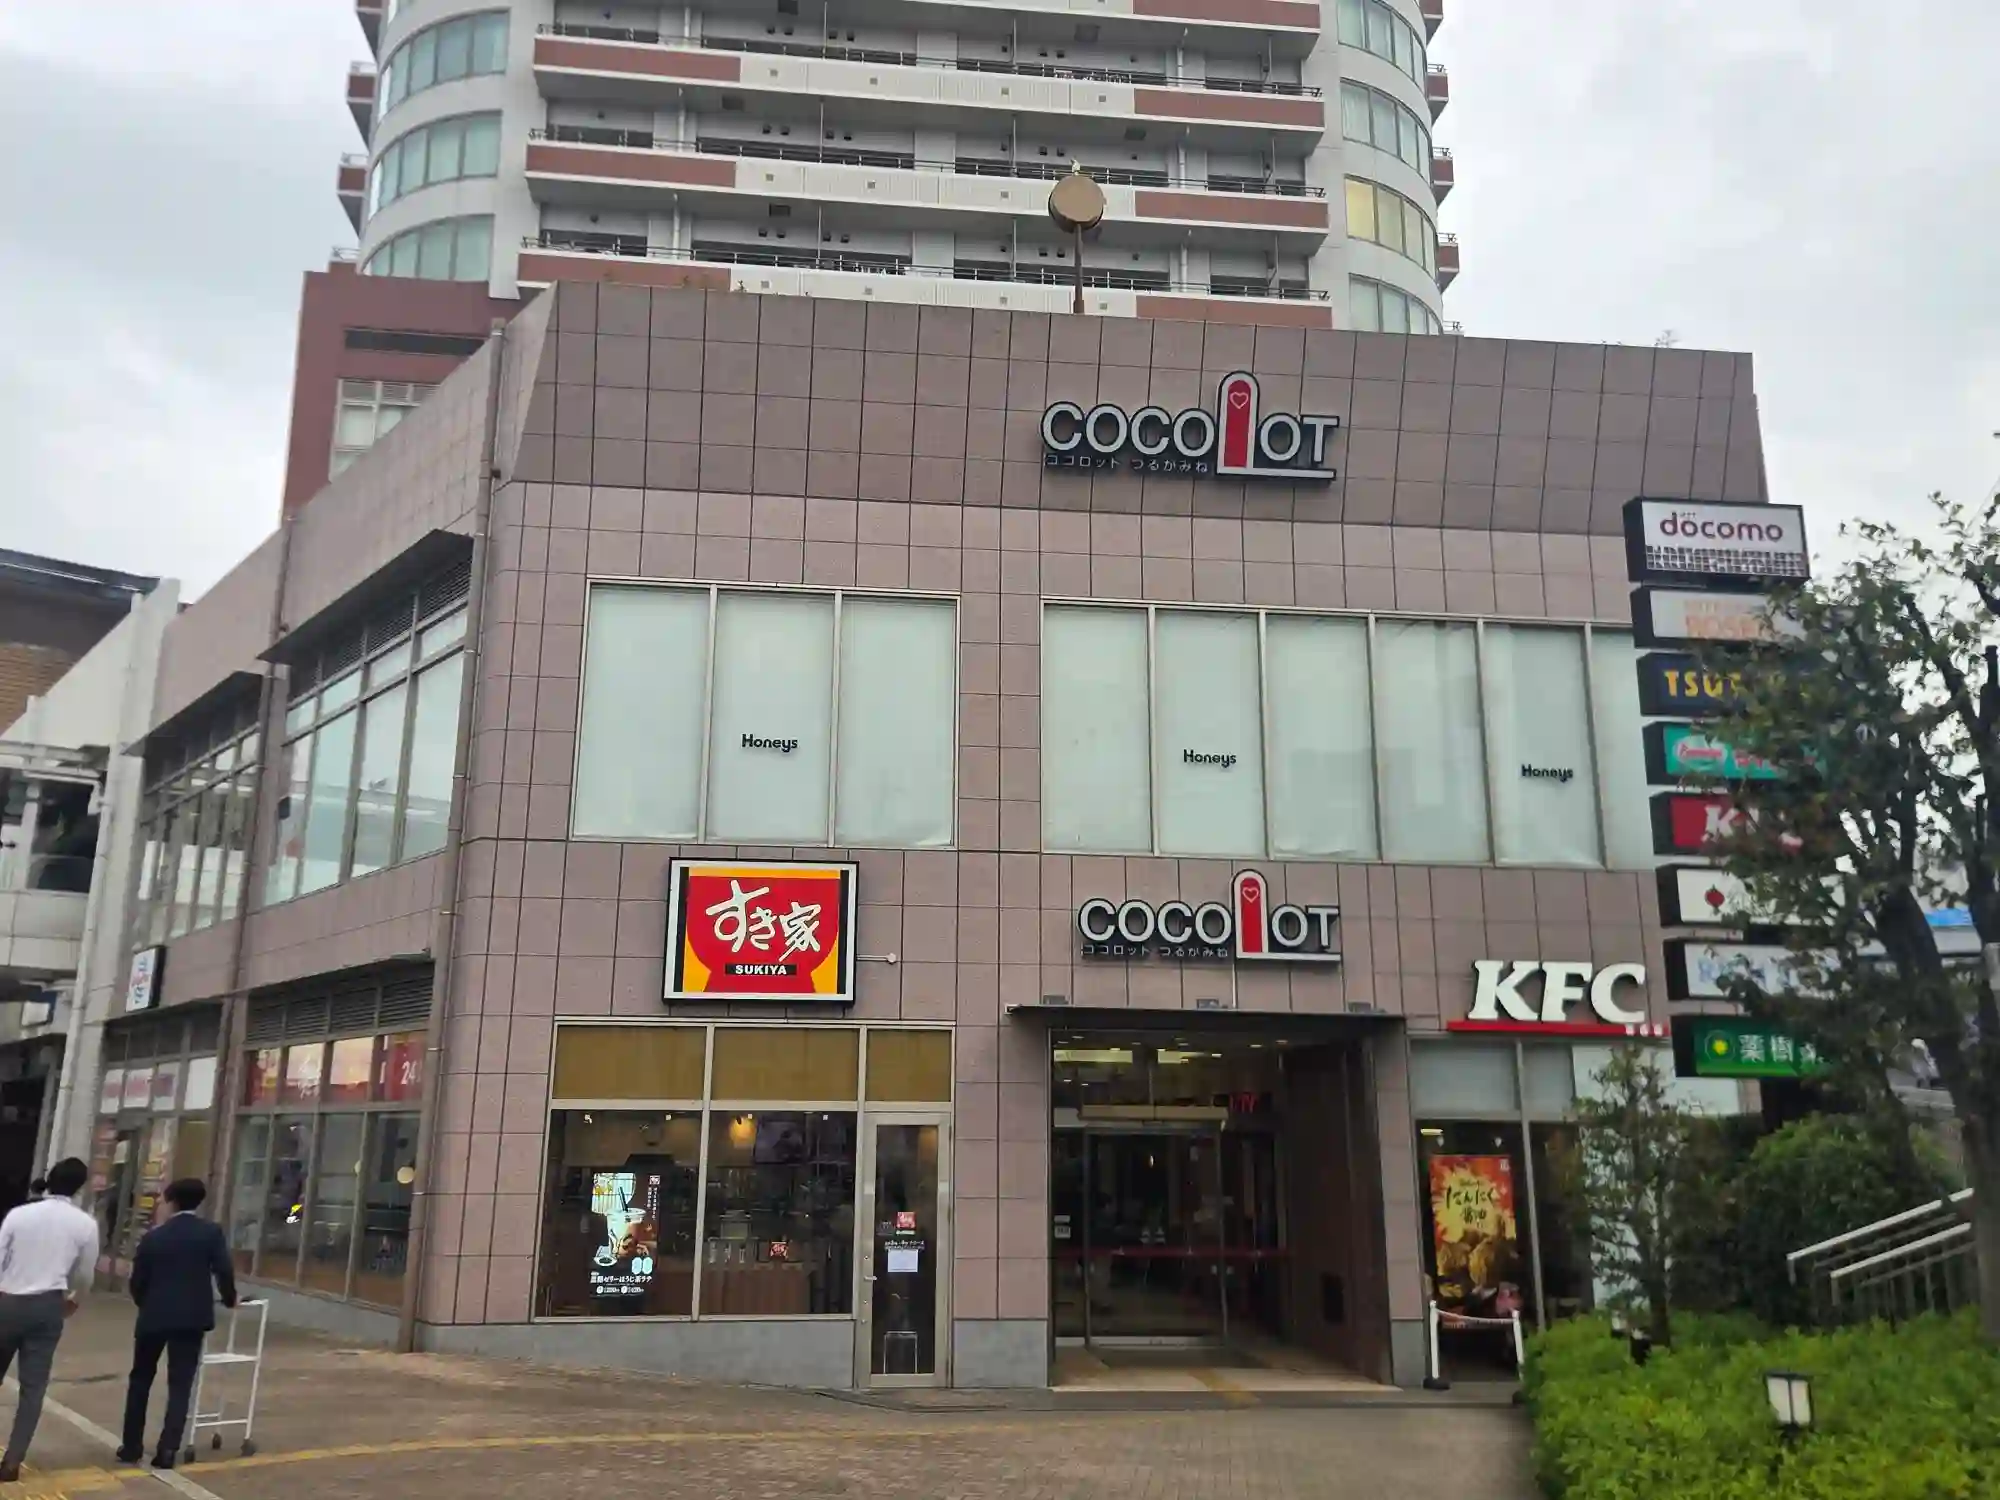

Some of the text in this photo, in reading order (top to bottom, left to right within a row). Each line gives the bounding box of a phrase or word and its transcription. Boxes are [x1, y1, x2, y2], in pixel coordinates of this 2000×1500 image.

[1044, 455, 1121, 469] ココロット
[1660, 512, 1783, 542] docomo
[1664, 671, 1742, 698] TSUT
[742, 733, 798, 753] Honeys
[1183, 748, 1237, 768] Honeys
[1521, 763, 1574, 783] Honeys
[705, 879, 822, 962] すき家
[1081, 944, 1149, 956] ココロット
[735, 964, 787, 975] SUKIYA
[1468, 960, 1646, 1024] KFC
